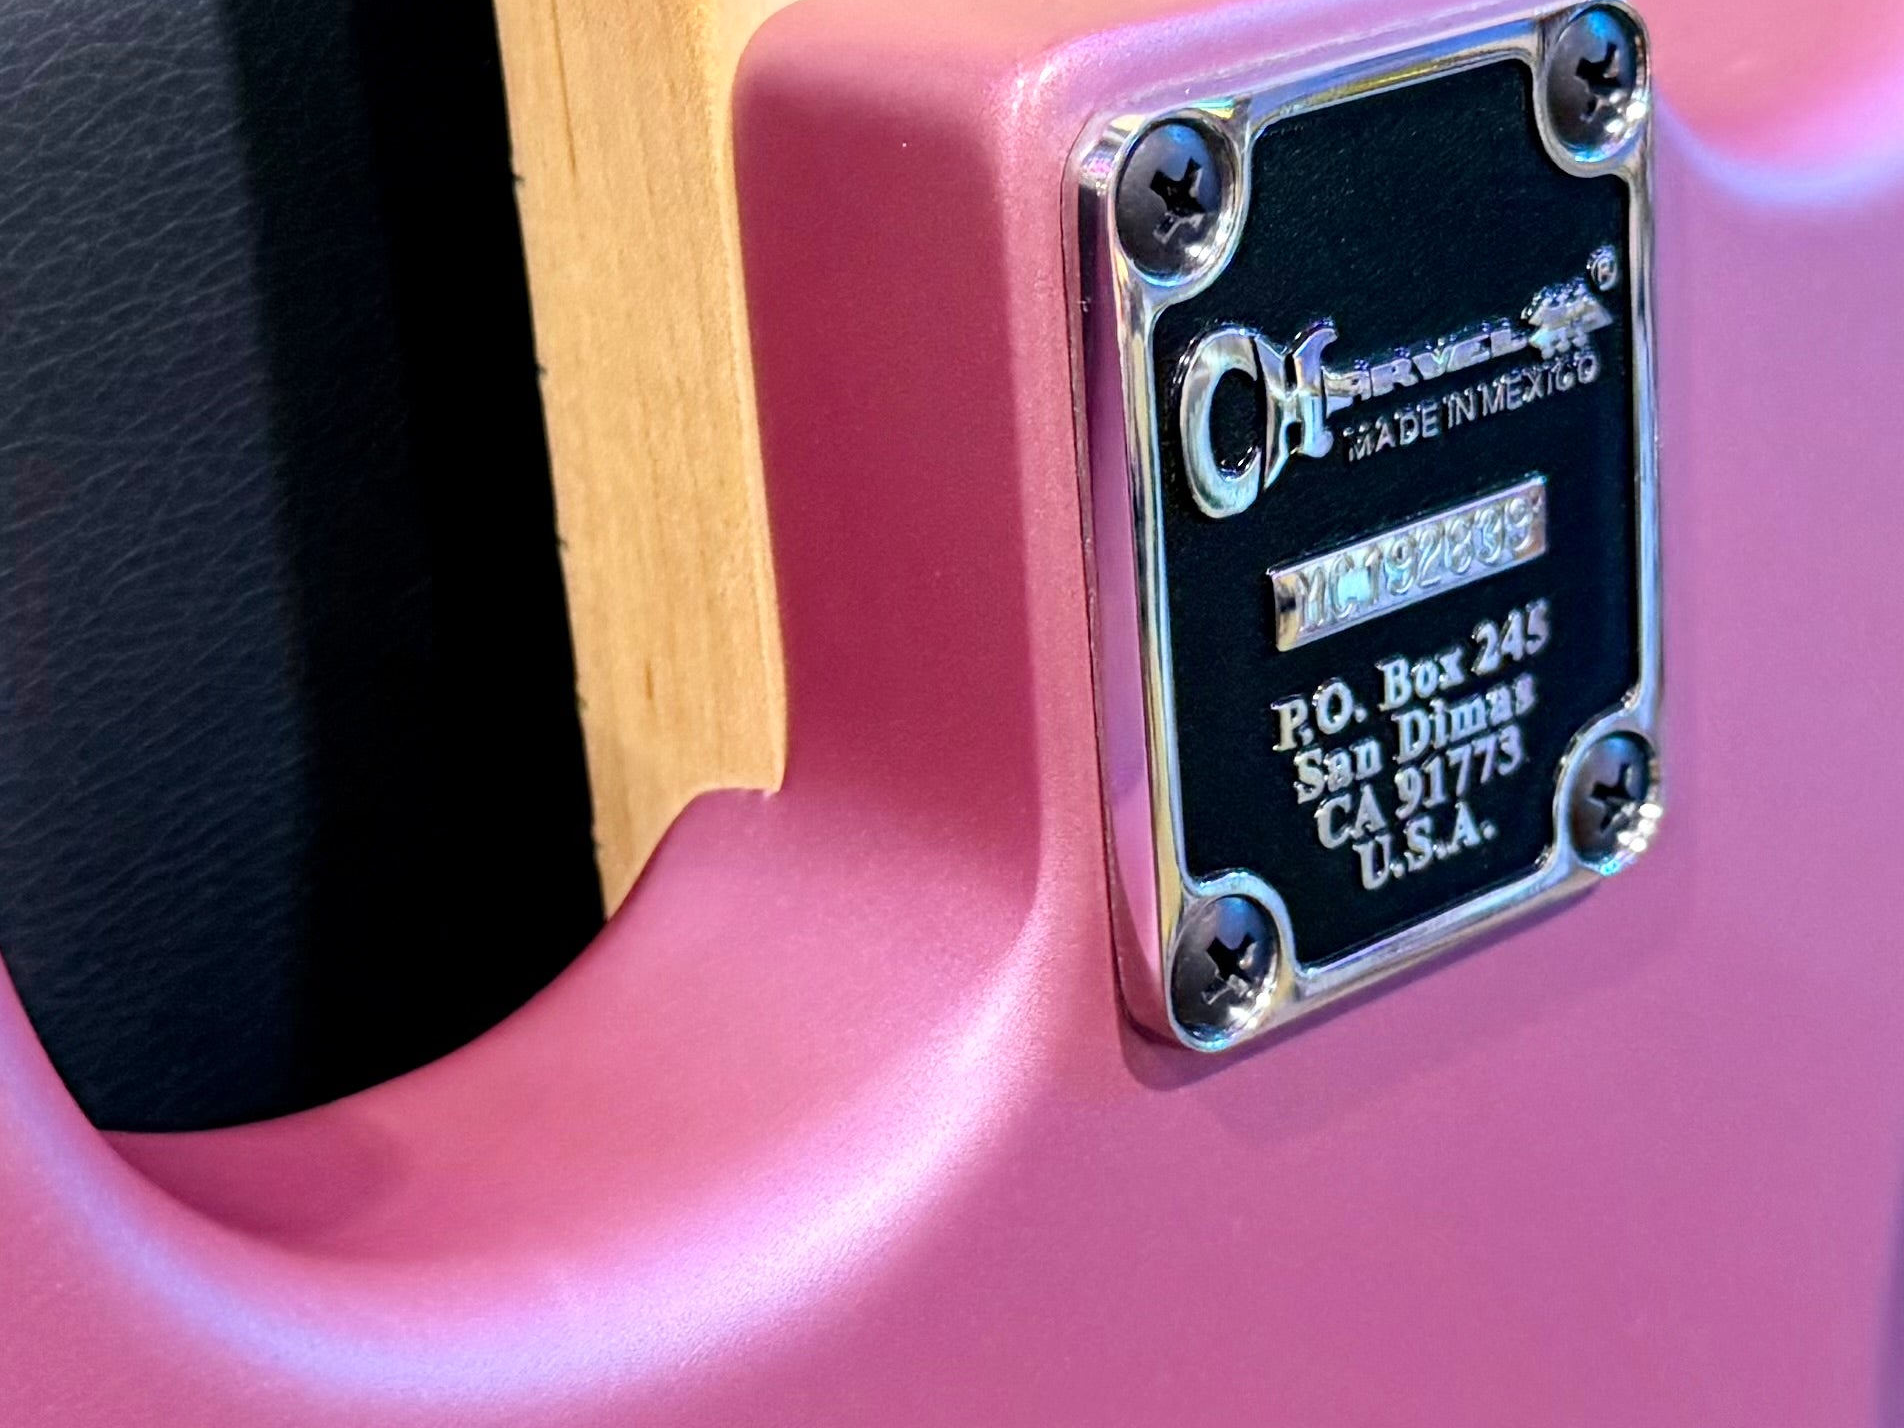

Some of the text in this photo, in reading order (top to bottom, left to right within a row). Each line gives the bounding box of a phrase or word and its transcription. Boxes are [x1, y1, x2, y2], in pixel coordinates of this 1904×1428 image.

[1347, 352, 1599, 462] MADE IN MEXICO
[1272, 598, 1549, 751] P.O. Box 245
[1294, 673, 1534, 804] San Dimas
[1315, 725, 1524, 849] CA 91773
[1353, 802, 1496, 890] U.S.A.
